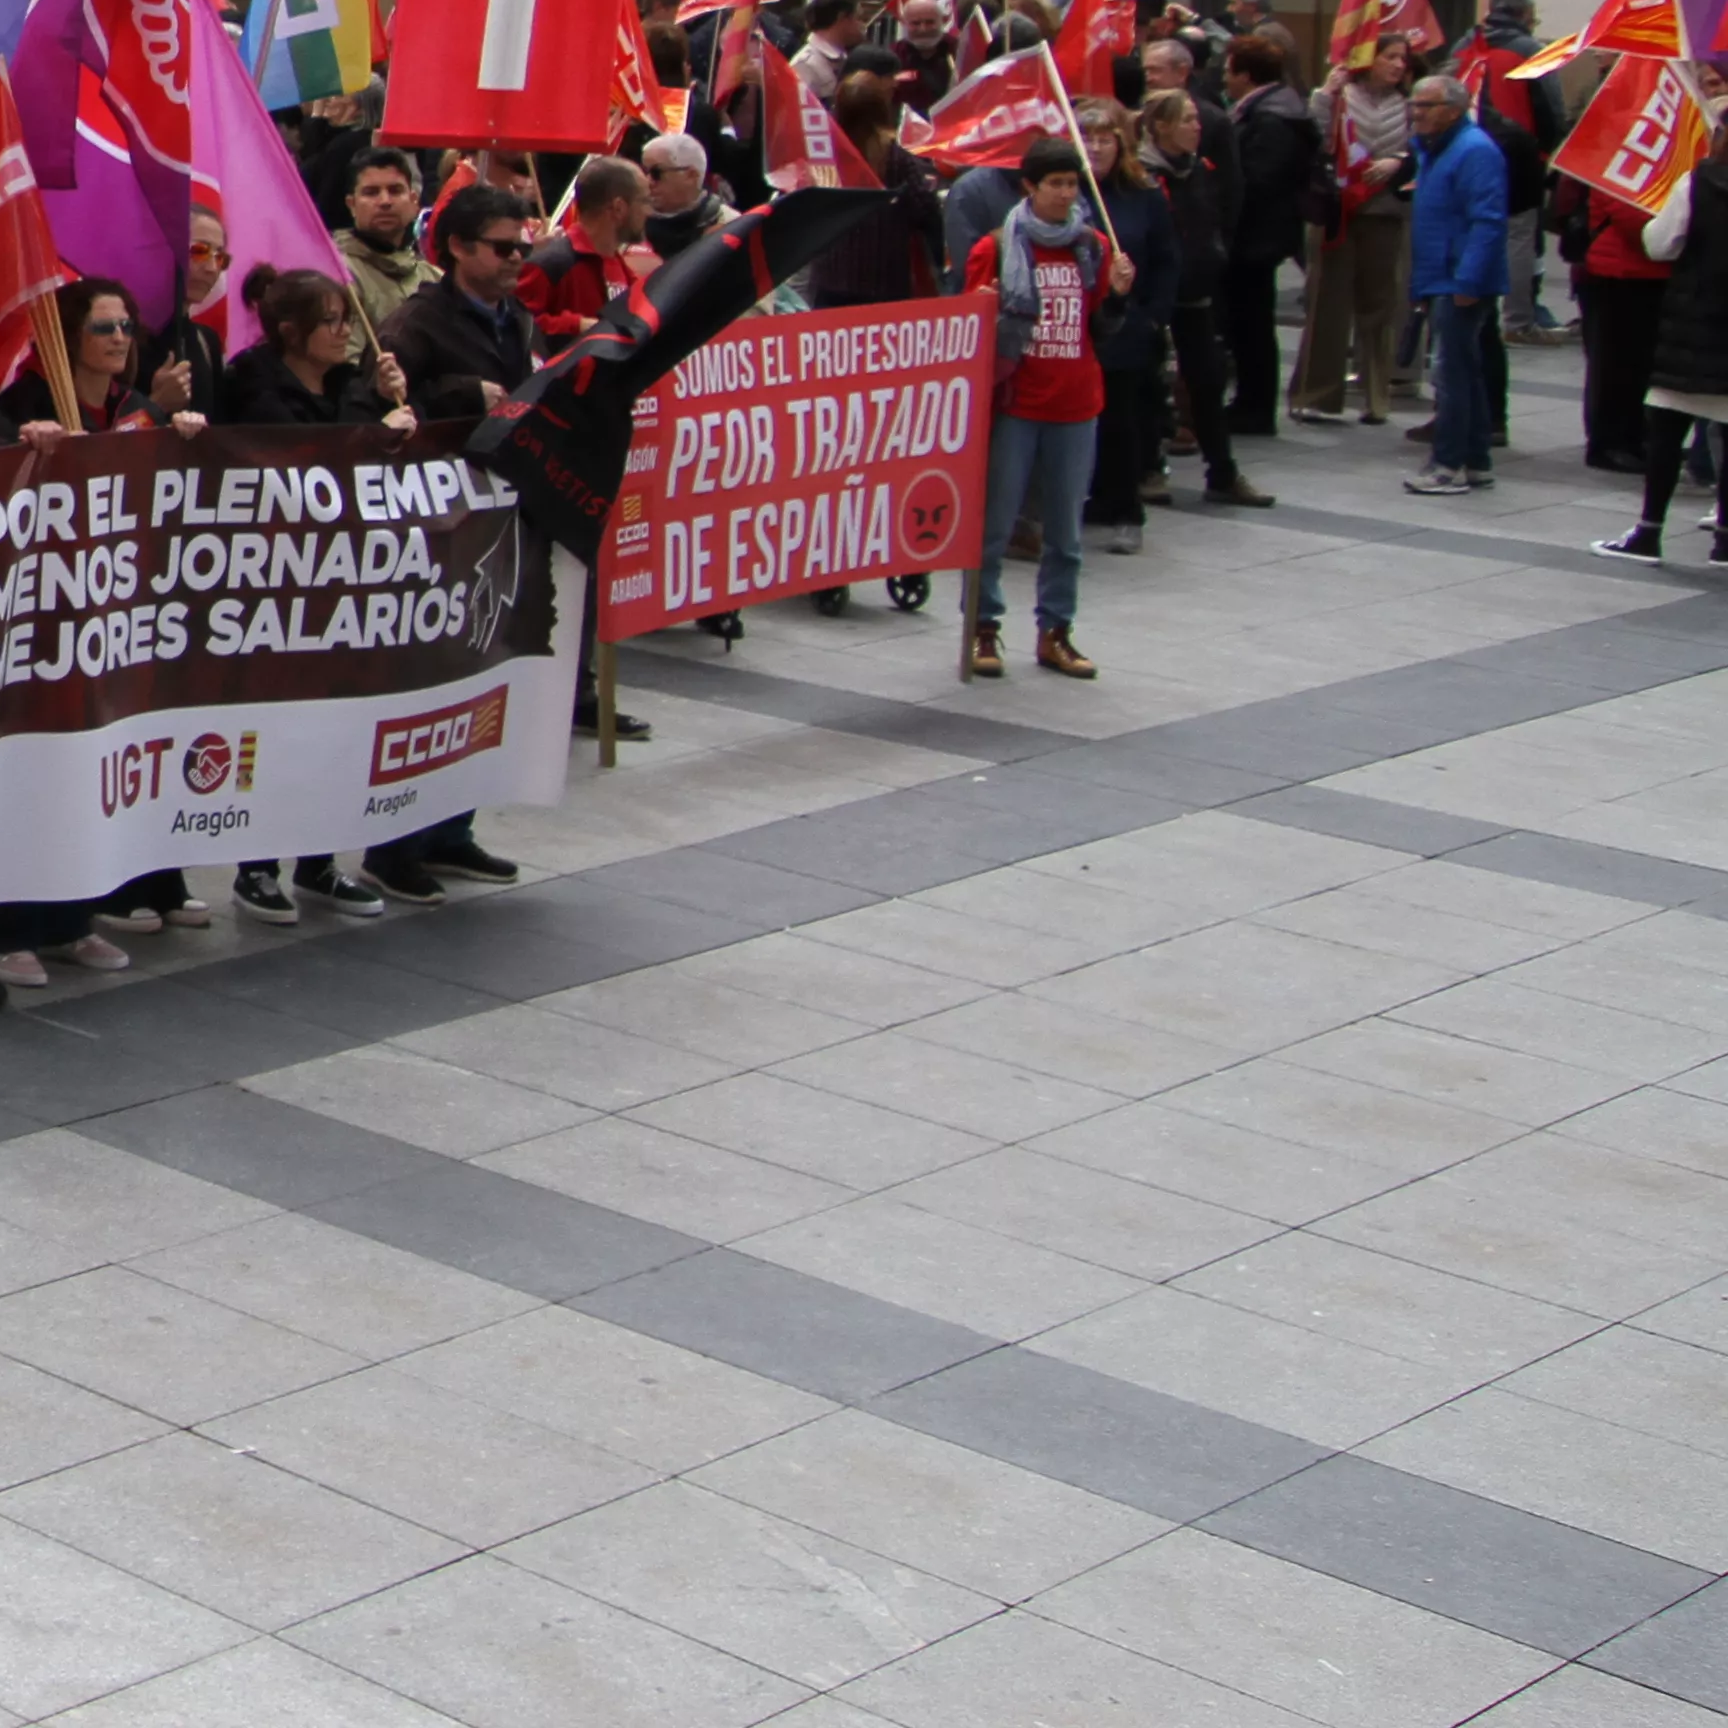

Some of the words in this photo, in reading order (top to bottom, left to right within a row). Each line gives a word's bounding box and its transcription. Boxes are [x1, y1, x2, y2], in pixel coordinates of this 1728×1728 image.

[1603, 68, 1683, 192] CCOO
[1035, 266, 1081, 288] OMOS
[1040, 297, 1082, 326] EOR
[674, 338, 754, 400] SOMOS
[763, 332, 792, 384] EL
[800, 314, 981, 379] PROFESORADO
[1032, 325, 1082, 343] RATADO
[666, 394, 776, 499] PEOR
[788, 376, 972, 478] TRATADO
[88, 475, 137, 536] EL
[151, 466, 344, 528] PLENO
[354, 459, 519, 522] EMPLE
[150, 527, 442, 595] JORNADA,
[664, 518, 713, 613] DE
[728, 473, 891, 597] ESPAÑA
[205, 581, 467, 654] SALARIOS
[381, 712, 469, 773] CCOO
[100, 738, 174, 819] UGT
[364, 786, 418, 819] Aragón
[171, 805, 250, 838] Aragón
